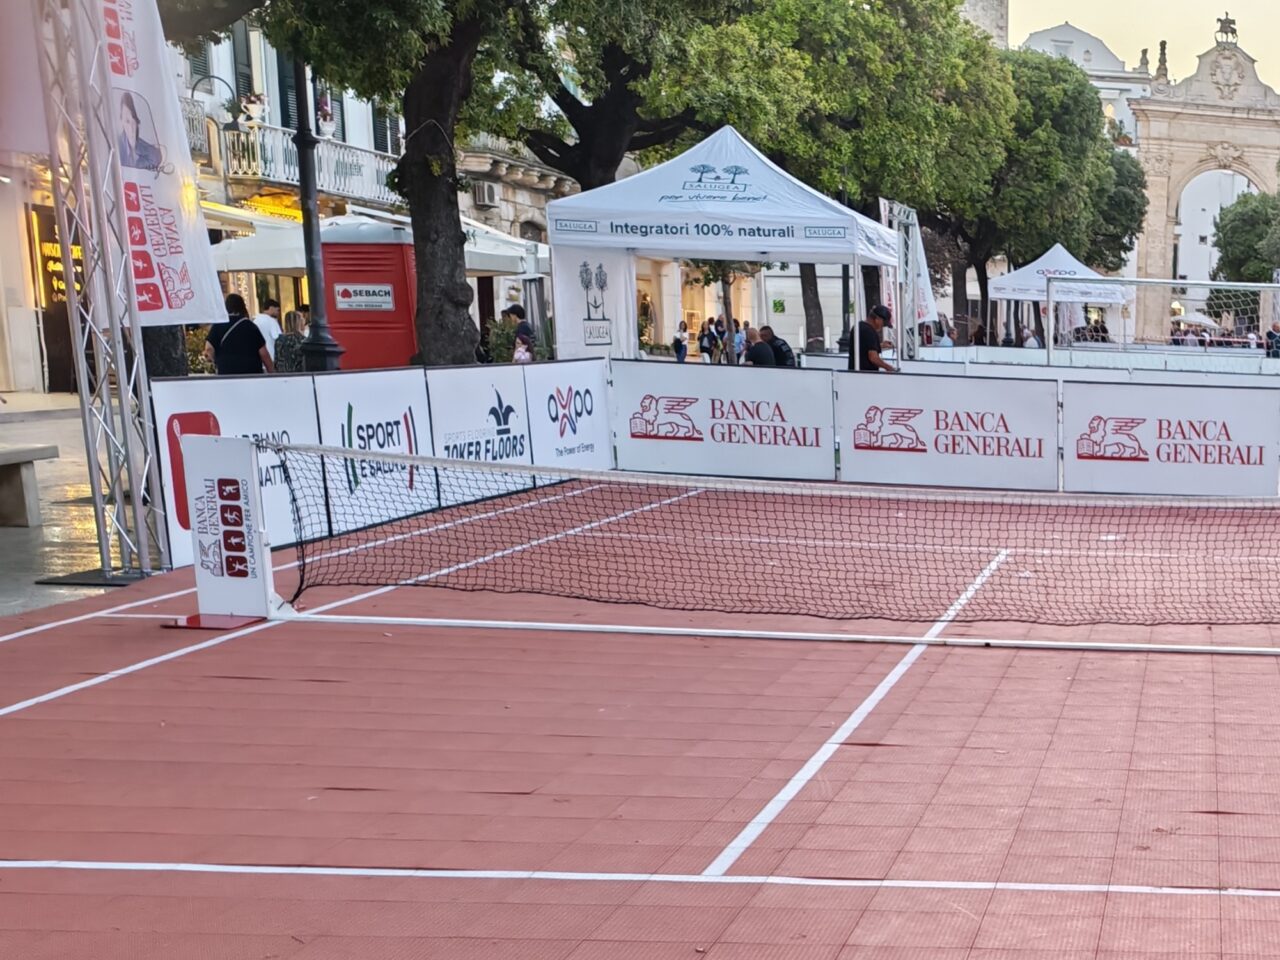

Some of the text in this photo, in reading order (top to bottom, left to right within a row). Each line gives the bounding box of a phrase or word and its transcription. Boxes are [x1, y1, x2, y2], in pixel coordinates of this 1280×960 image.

[658, 194, 683, 203] per
[688, 183, 740, 191] SALUGEA
[558, 221, 594, 231] SALUGEA
[610, 221, 795, 238] Integratori 100% naturali
[808, 229, 842, 237] SALUGEA
[353, 289, 391, 298] SEBACH
[585, 324, 610, 339] SALUGEA
[547, 385, 594, 439] axpo
[709, 398, 788, 423] BANCA
[933, 409, 1011, 433] BANCA
[356, 420, 401, 450] SPORT
[710, 423, 822, 448] GENERALI
[1157, 418, 1233, 441] BANCA
[485, 433, 525, 462] FLOORS
[934, 434, 1044, 458] GENERALI
[1156, 443, 1265, 465] GENERALI
[241, 479, 249, 505] AMICO
[195, 495, 209, 535] BANCA
[204, 478, 220, 536] GENERALI
[246, 525, 256, 566] CAMPIONE
